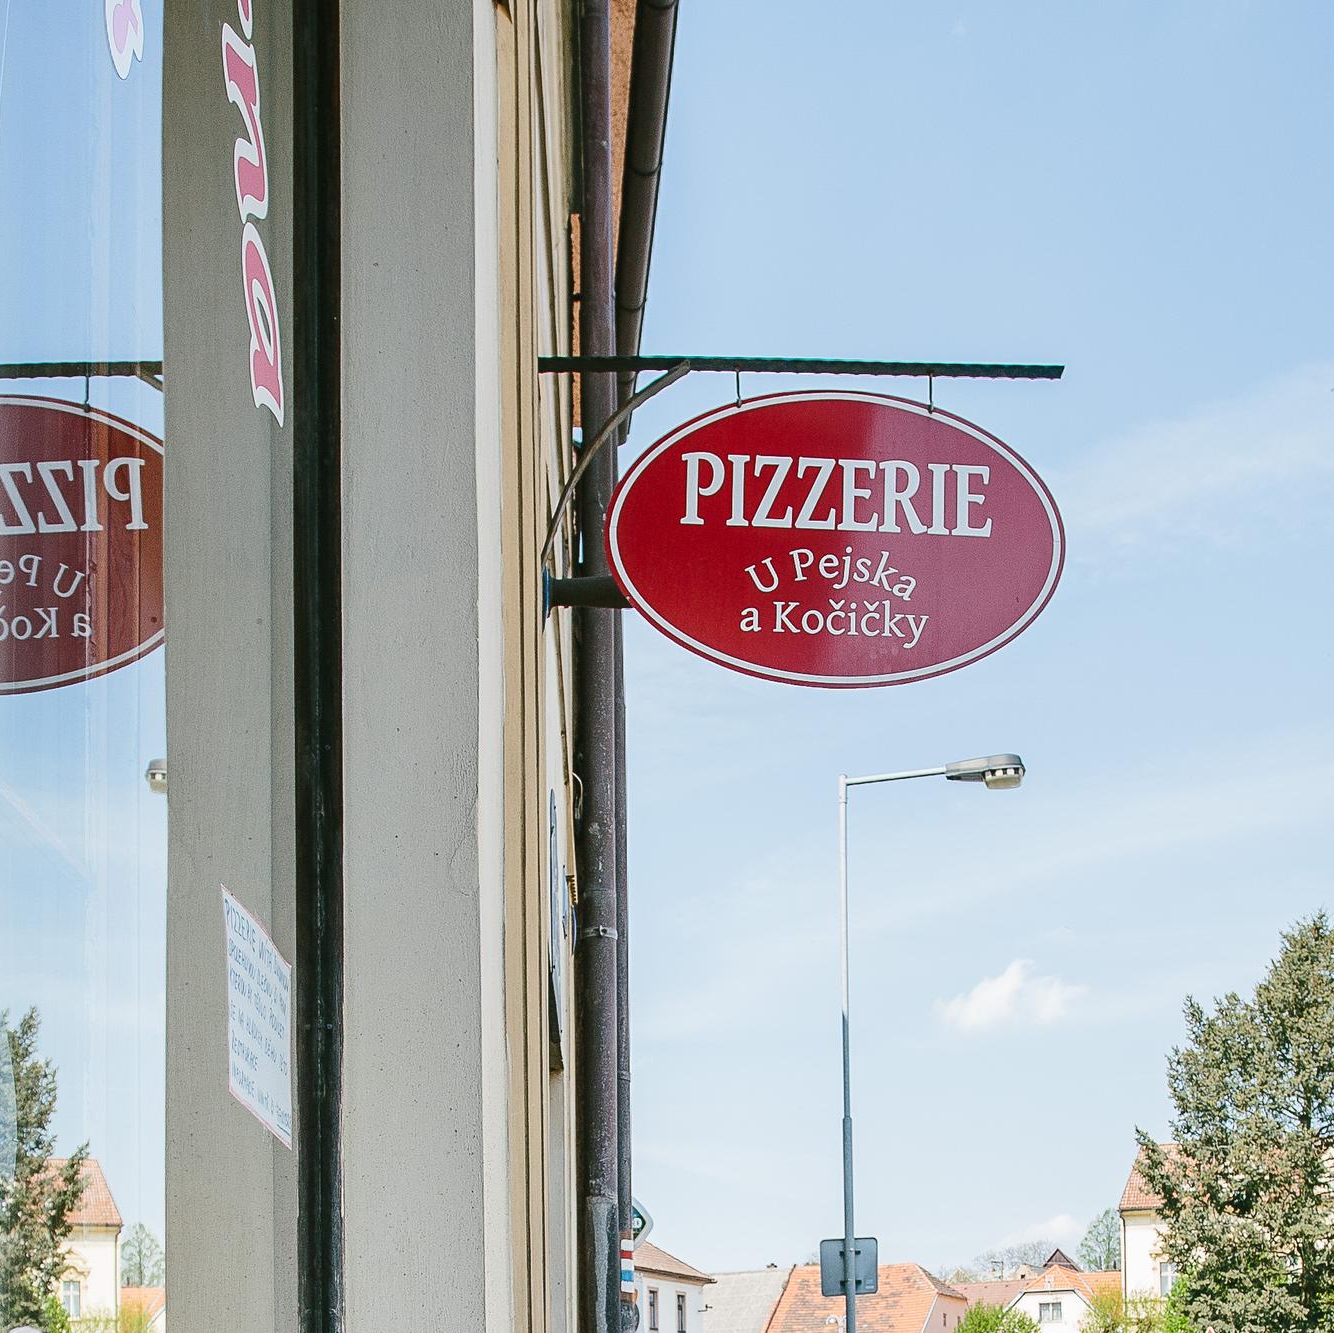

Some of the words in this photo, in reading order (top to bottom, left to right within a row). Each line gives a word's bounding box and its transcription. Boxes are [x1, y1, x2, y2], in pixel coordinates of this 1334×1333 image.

[222, 0, 285, 428] rna
[679, 451, 993, 538] PIZZERIE
[744, 557, 779, 594] U
[789, 546, 917, 601] Pejska
[739, 606, 762, 633] a
[772, 599, 930, 649] Kočičky
